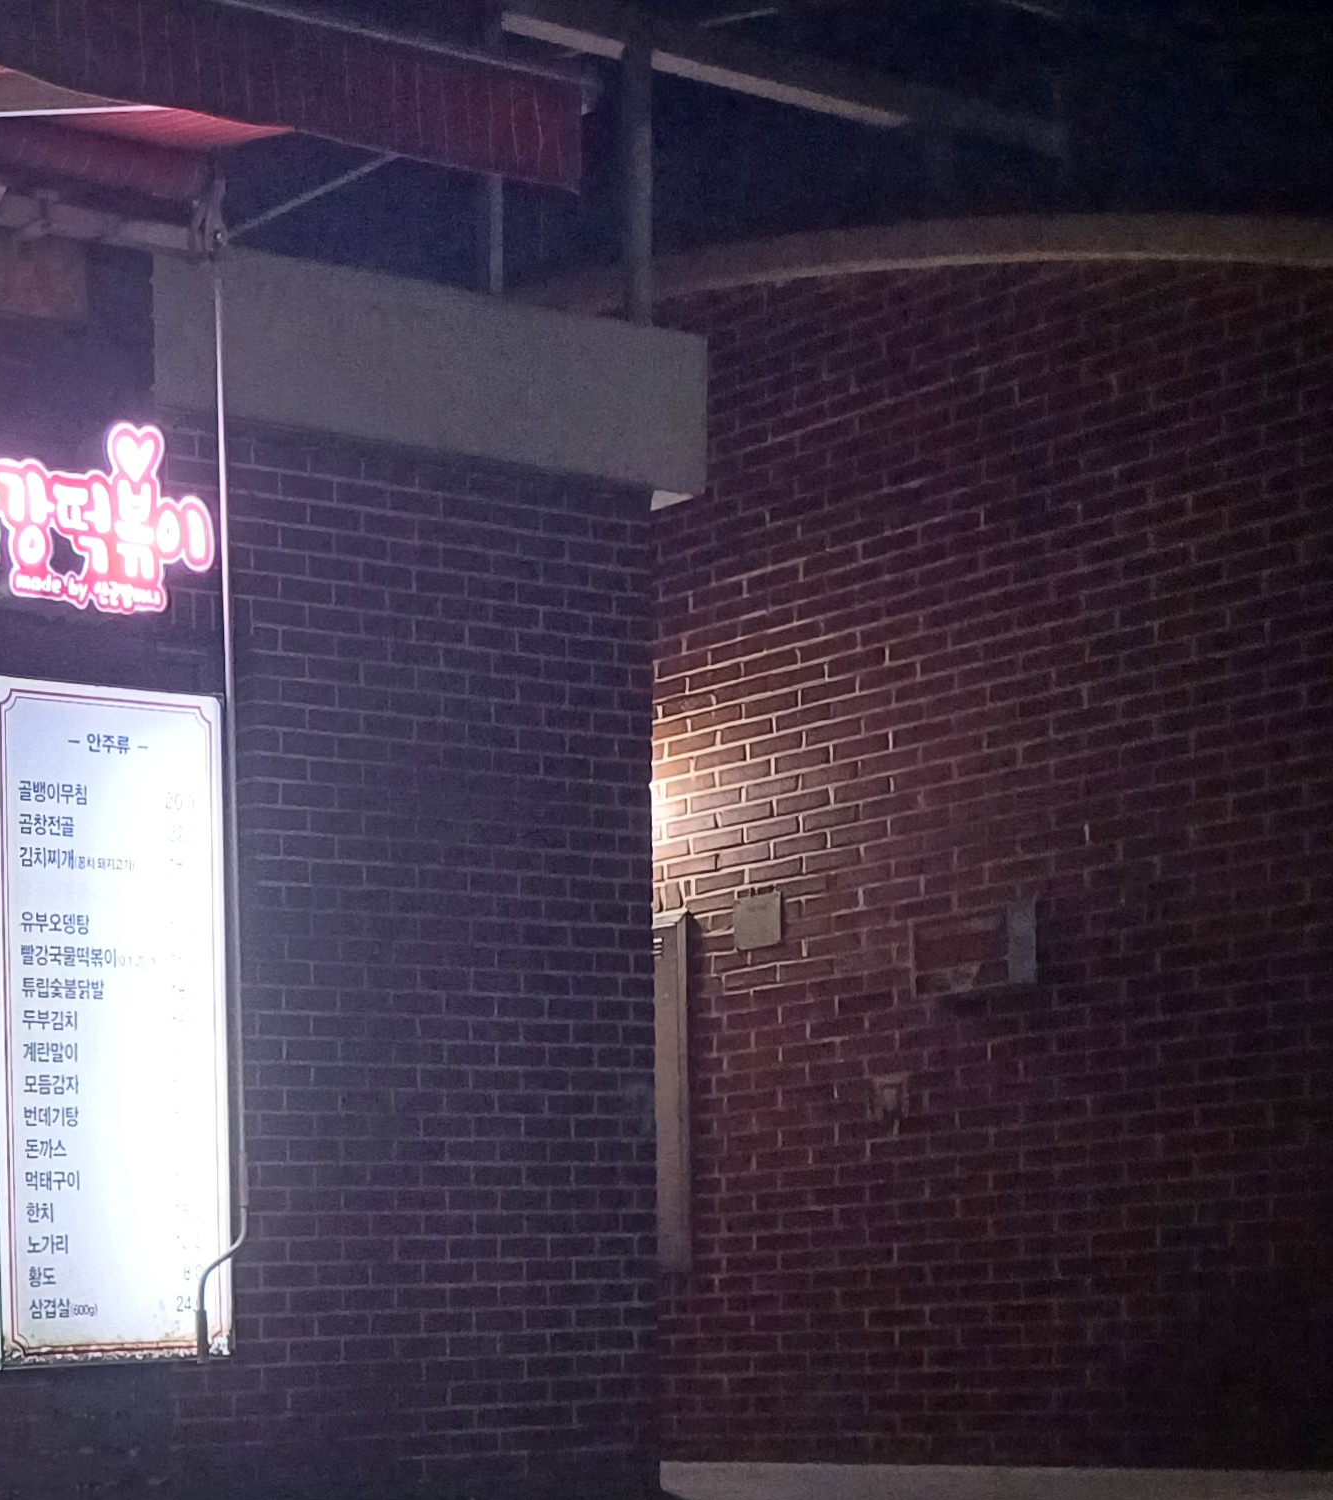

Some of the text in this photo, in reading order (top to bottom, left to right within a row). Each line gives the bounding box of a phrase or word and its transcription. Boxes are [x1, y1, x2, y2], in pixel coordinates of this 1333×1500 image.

[15, 574, 62, 594] made
[68, 575, 88, 601] by
[87, 733, 130, 755] 안주류
[18, 780, 88, 806] 골뱅이무침
[20, 911, 90, 935] 유부오뎅탕
[22, 1009, 78, 1031] 두부김치
[23, 1042, 79, 1063] 계란말이
[24, 1074, 80, 1095] 모듬감자
[24, 1106, 80, 1128] 번데기탕
[25, 1138, 68, 1160] 돈까스
[25, 1170, 81, 1191] 먹태구이
[26, 1202, 55, 1223] 한치
[27, 1234, 69, 1255] 노가리
[28, 1266, 57, 1288] 황도
